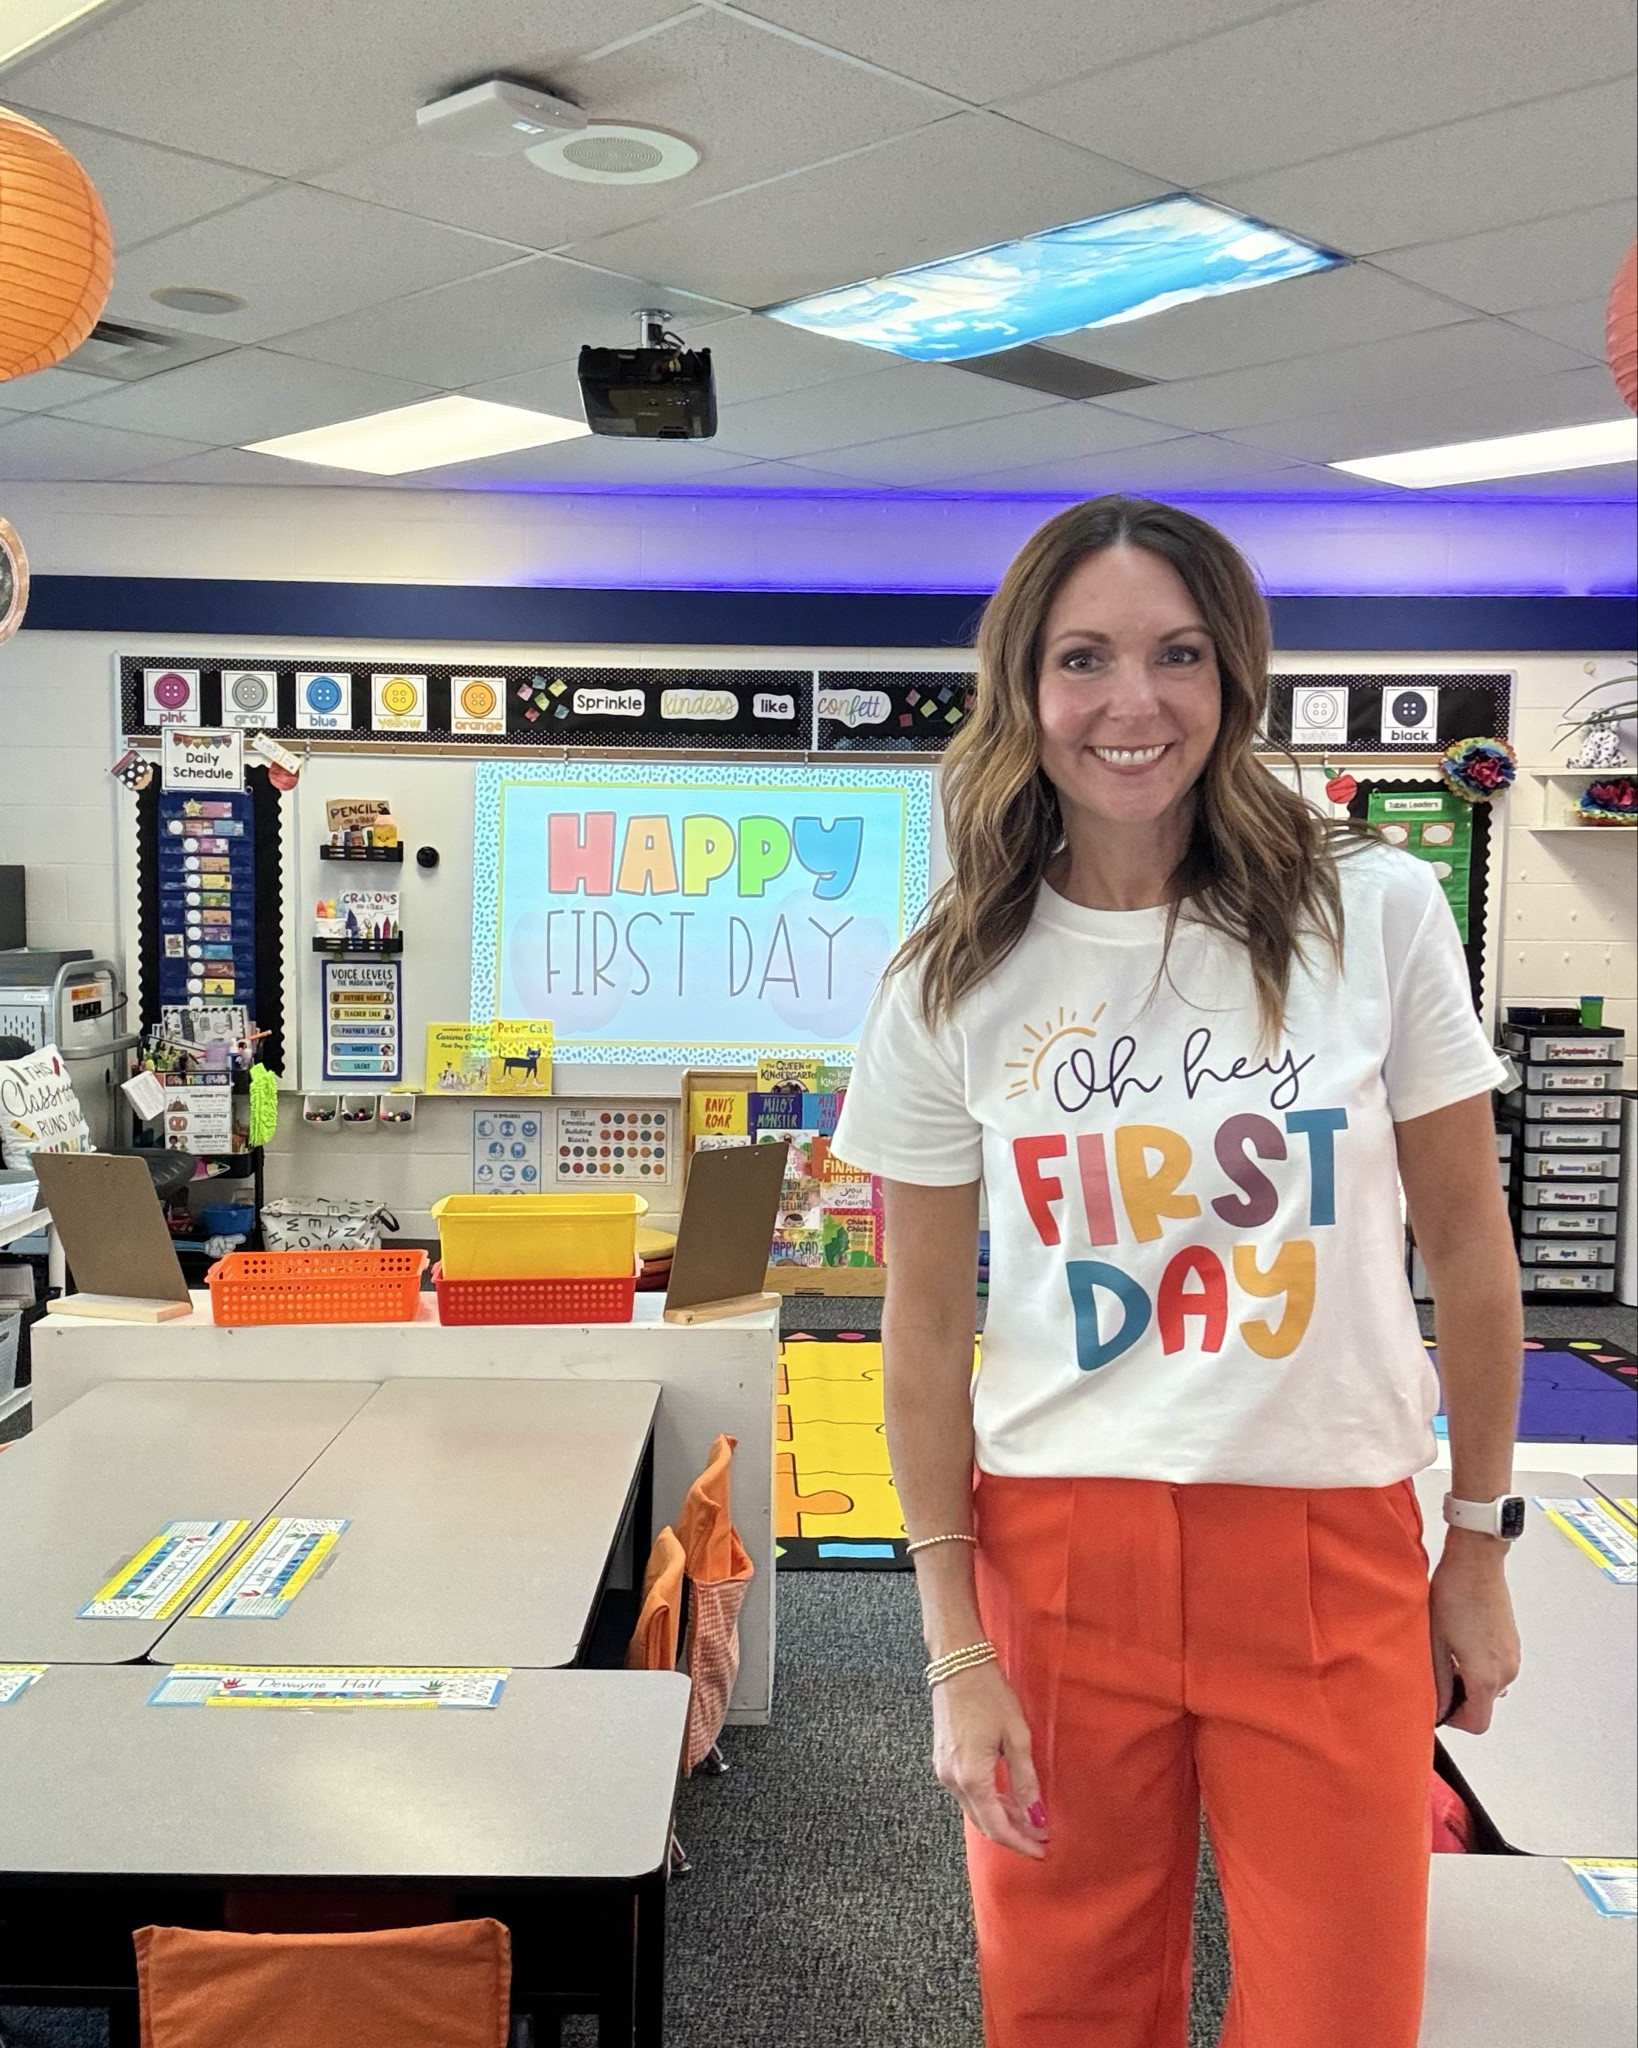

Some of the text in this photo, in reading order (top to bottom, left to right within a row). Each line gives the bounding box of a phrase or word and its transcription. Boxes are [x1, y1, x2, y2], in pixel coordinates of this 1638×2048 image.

[577, 694, 642, 711] Sprinkle
[760, 699, 788, 713] like
[817, 694, 887, 726] confett
[159, 712, 187, 725] pink
[234, 715, 267, 727] gray
[310, 714, 338, 727] blue
[378, 716, 421, 729] yellow
[455, 720, 504, 732] orange
[1391, 730, 1429, 741] black
[185, 752, 220, 767] Daily
[173, 767, 234, 780] Schedule
[330, 803, 385, 820] PENCILS
[1409, 801, 1439, 809] Leaders
[547, 811, 864, 900] HAPPY
[343, 892, 397, 905] CRAYONS
[546, 909, 855, 1000] FIRST DAY
[331, 968, 393, 980] VOICE LEVELS
[497, 1022, 522, 1034] Pete
[529, 1023, 549, 1034] Cat
[23, 1062, 53, 1081] THIS
[776, 1060, 805, 1071] QUEEN
[1053, 1027, 1316, 1112] Oh hey
[704, 1097, 735, 1113] RAVI'S
[762, 1097, 794, 1113] MILO'S
[37, 1114, 68, 1138] RUNS
[704, 1114, 732, 1128] ROAR
[756, 1114, 798, 1128] MONSTER
[1012, 1107, 1349, 1247] FIRST
[840, 1187, 862, 1197] you
[834, 1196, 872, 1208] enough
[771, 1241, 820, 1257] APPY-SAD
[1065, 1239, 1316, 1371] DAY
[258, 1677, 382, 1691] Dewayne Hall
